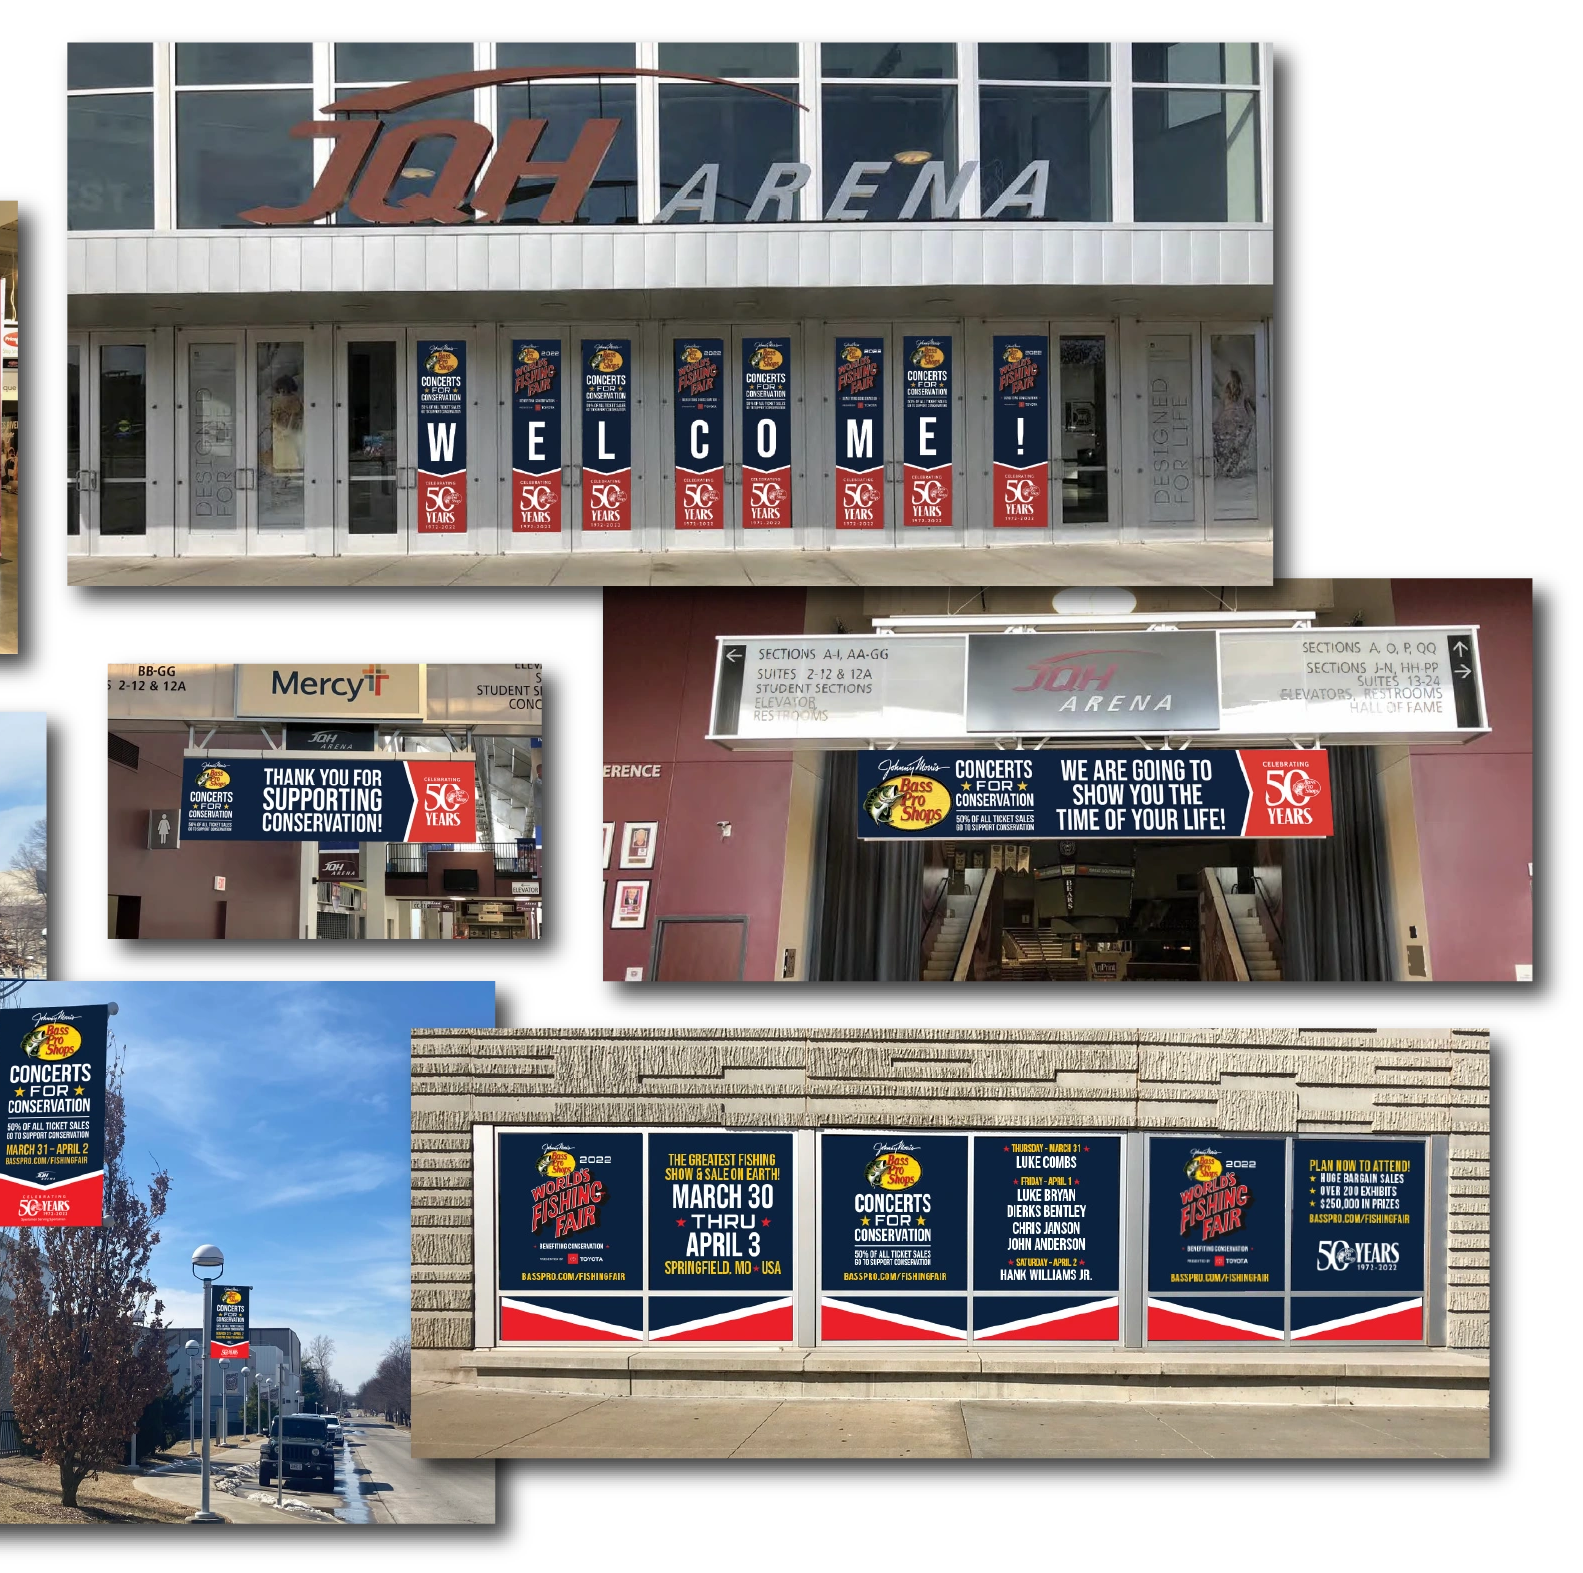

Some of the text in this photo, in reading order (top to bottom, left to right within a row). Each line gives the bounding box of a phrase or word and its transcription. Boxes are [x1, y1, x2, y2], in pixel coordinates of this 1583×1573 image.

[238, 117, 1051, 225] JQH ARENA
[421, 376, 461, 387] CONCERTS
[427, 423, 456, 461] W
[529, 421, 545, 460] E
[599, 421, 615, 459] L
[690, 419, 709, 459] C
[757, 419, 776, 458] O
[847, 419, 873, 458] M
[919, 417, 937, 455] E
[1152, 379, 1170, 504] DESIGNED
[1172, 397, 1189, 503] FOR LIFE
[426, 512, 455, 523] YEARS
[759, 649, 888, 661] SECTIONS A-I, AA-GG
[1303, 642, 1361, 653] SECTIONS
[1370, 643, 1381, 654] A,
[1417, 642, 1436, 655] QQ
[138, 666, 176, 677] BB-GG
[758, 669, 872, 680] SUITES 2-12 & 12A
[1307, 662, 1438, 676] SECTIONS J-N, HH-PP
[1012, 663, 1118, 691] JQH
[1357, 676, 1440, 687] SUITES 13-24
[119, 680, 186, 691] 2-12 & 12A
[272, 670, 364, 702] Mercy
[477, 685, 529, 696] STUDENT
[756, 684, 872, 694] STUDENT SECTIONS
[1364, 688, 1443, 699] RESTROOMS
[1059, 695, 1172, 712] ARENA
[308, 733, 337, 743] JQH
[603, 765, 661, 778] ERENCE
[956, 760, 1032, 779] CONCERTS
[1061, 759, 1212, 781] WE ARE GOING TO
[264, 769, 382, 787] THANK YOU FOR
[977, 781, 1013, 791] FOR
[263, 787, 382, 812] SUPPORTING
[956, 794, 1034, 807] CONSERVATION
[1073, 784, 1203, 805] SHOW YOU THE
[262, 812, 382, 833] CONSERVATION!
[425, 812, 461, 826] YEARS
[956, 815, 1034, 823] 50% OF ALL TICKET SALES
[1056, 808, 1226, 830] TIME OF YOUR LIFE!
[10, 1063, 91, 1083] CONCERTS
[31, 1086, 69, 1097] FOR
[8, 1098, 90, 1114] CONSERVATION
[6, 1143, 89, 1156] MARCH 31 APRIL 2
[668, 1153, 776, 1167] THE GREATEST FISHING
[1310, 1159, 1411, 1173] PLAN NOW TO ATTEND!
[672, 1184, 774, 1210] MARCH 30
[692, 1215, 756, 1229] THRU
[686, 1232, 761, 1257] APRIL 3
[664, 1260, 781, 1275] SPRINGFIELD, MO USA
[521, 1271, 626, 1282] BASSPRO.COM/FISHINGFAIR
[1000, 1269, 1093, 1281] HANK WILLIAMS JR.
